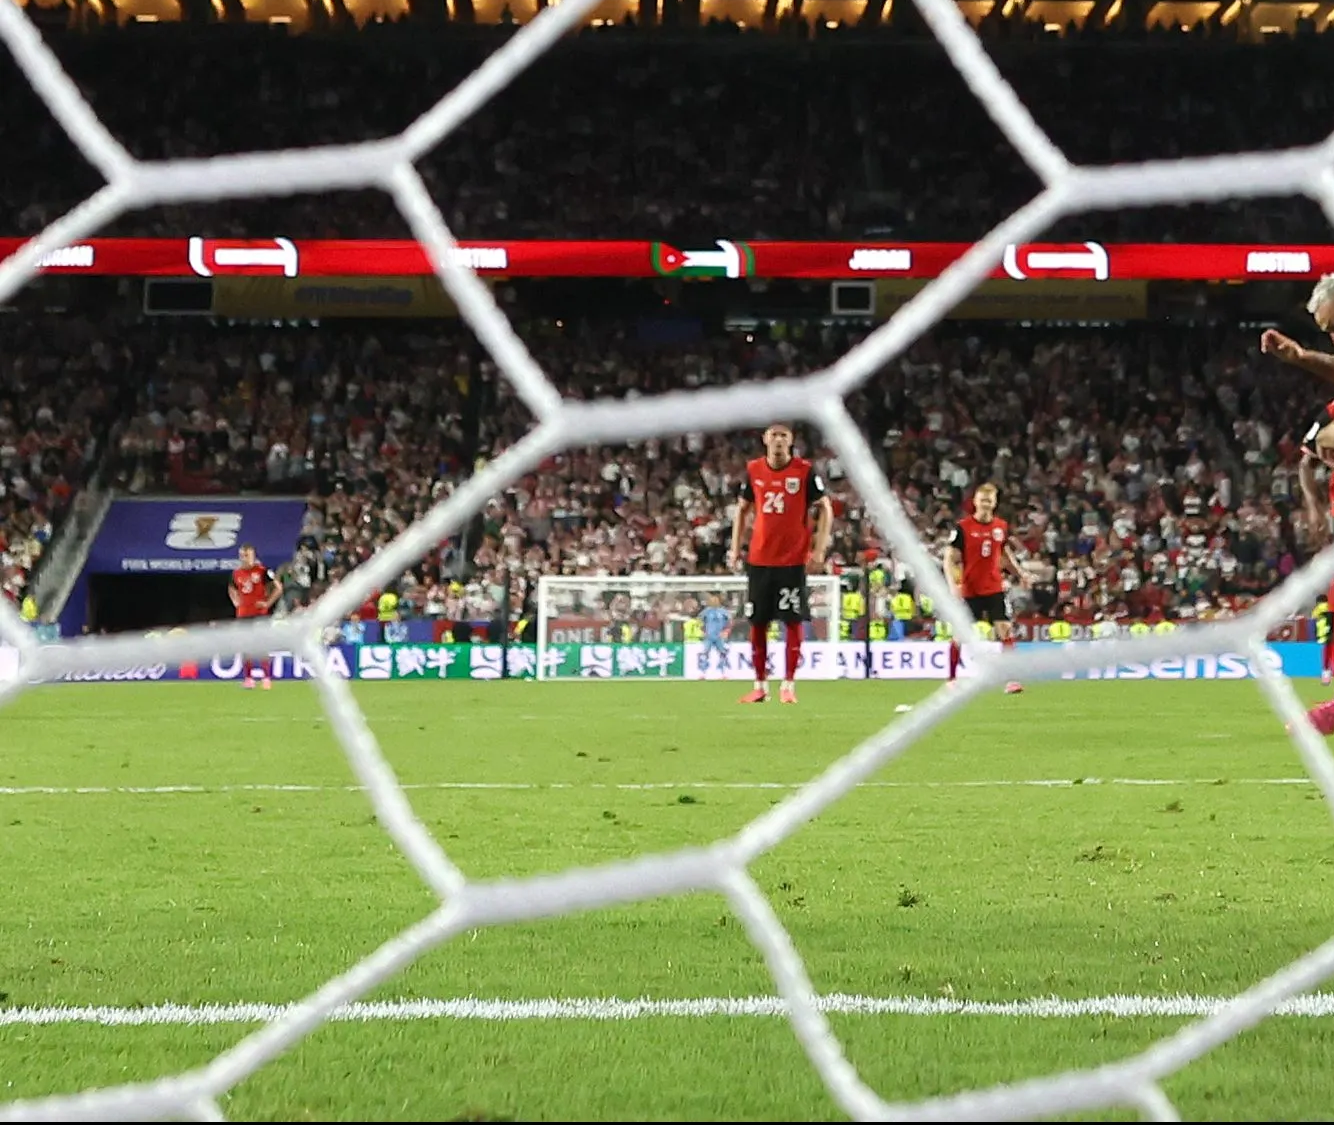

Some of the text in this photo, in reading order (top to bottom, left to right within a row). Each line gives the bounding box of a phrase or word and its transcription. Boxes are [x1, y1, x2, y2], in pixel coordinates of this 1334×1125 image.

[762, 491, 785, 514] 24
[778, 587, 801, 614] 24
[210, 648, 351, 679] UTRA
